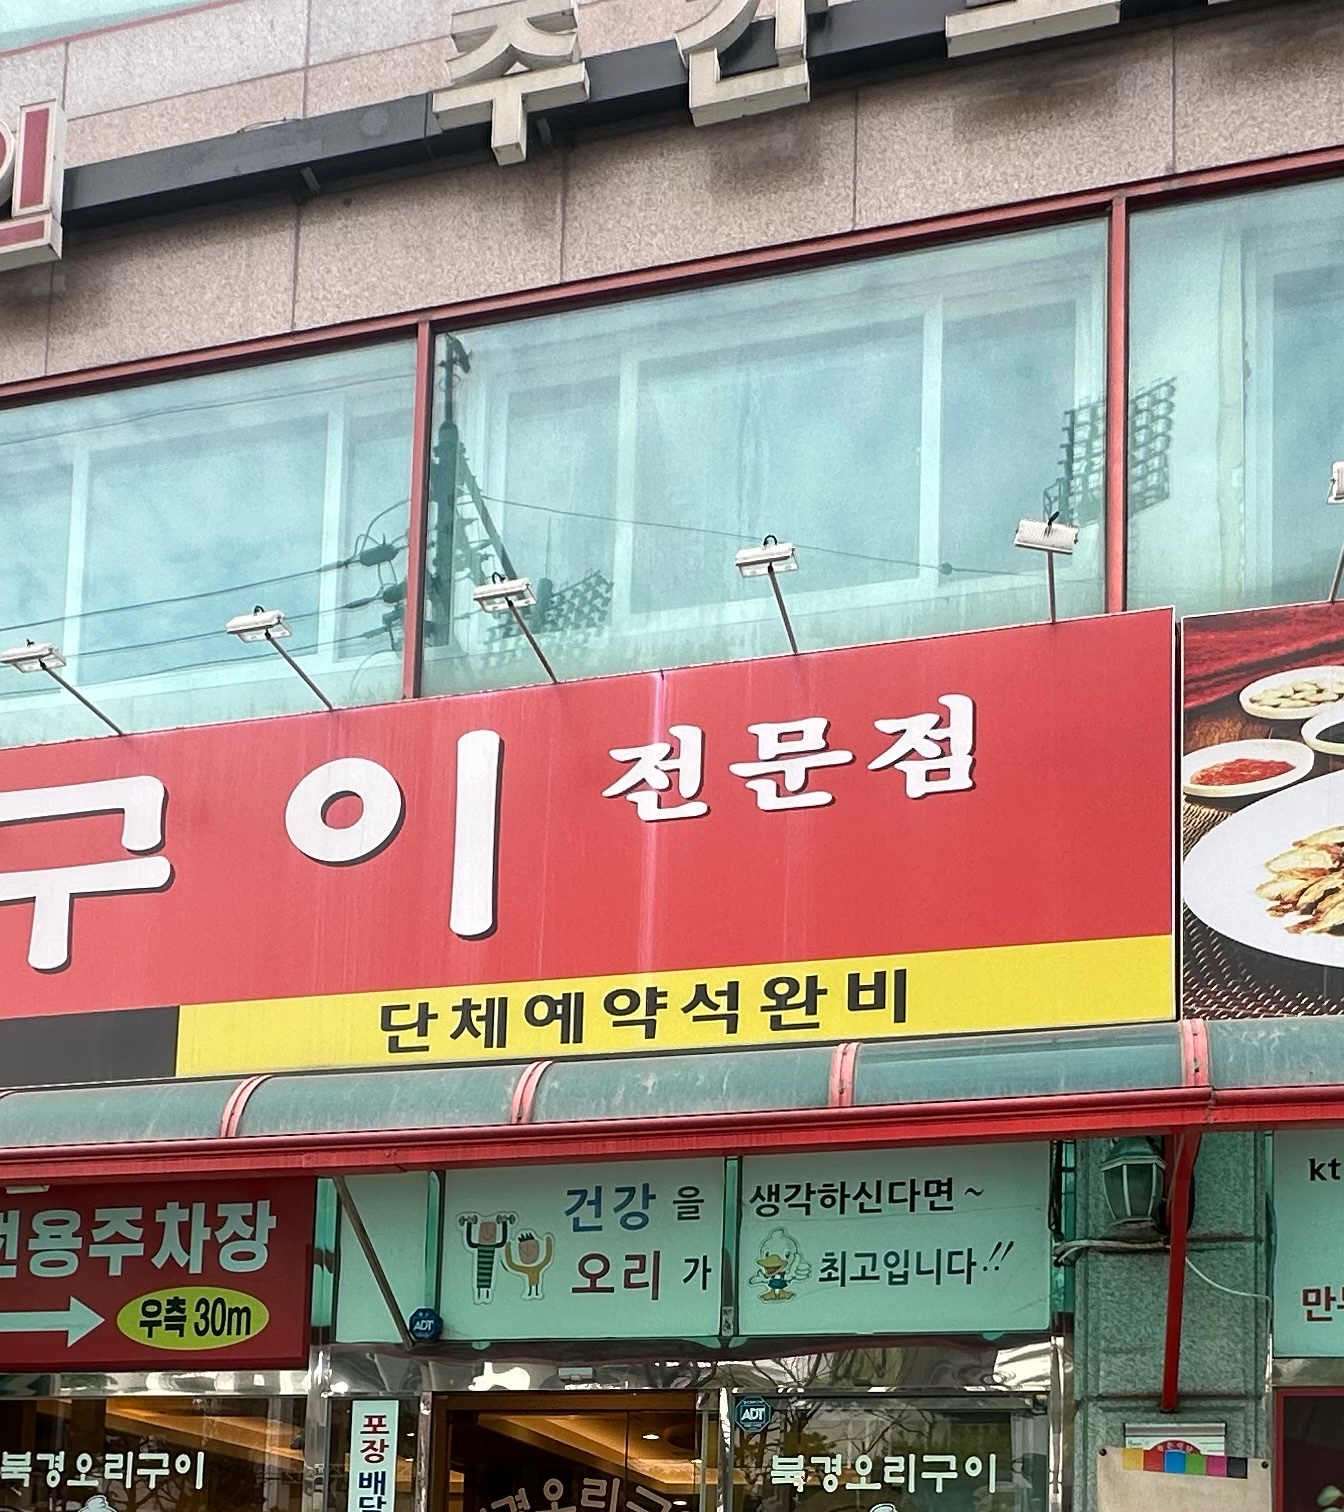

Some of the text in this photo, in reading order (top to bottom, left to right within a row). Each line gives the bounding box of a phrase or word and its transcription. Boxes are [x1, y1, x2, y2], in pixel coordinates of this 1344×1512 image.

[602, 692, 978, 823] 전문점
[379, 967, 912, 1055] 단체예약석완비
[1308, 1157, 1341, 1182] kt
[563, 1182, 657, 1234] 건강
[671, 1184, 705, 1222] 을
[571, 1249, 661, 1301] 오리
[682, 1253, 713, 1292] 가
[139, 1296, 252, 1339] 우측 30m
[413, 1320, 434, 1331] ADT
[741, 1407, 766, 1421] ADT
[360, 1415, 390, 1464] 포장
[0, 1450, 205, 1490] 북경오리구이
[771, 1453, 997, 1494] 북경오리구이
